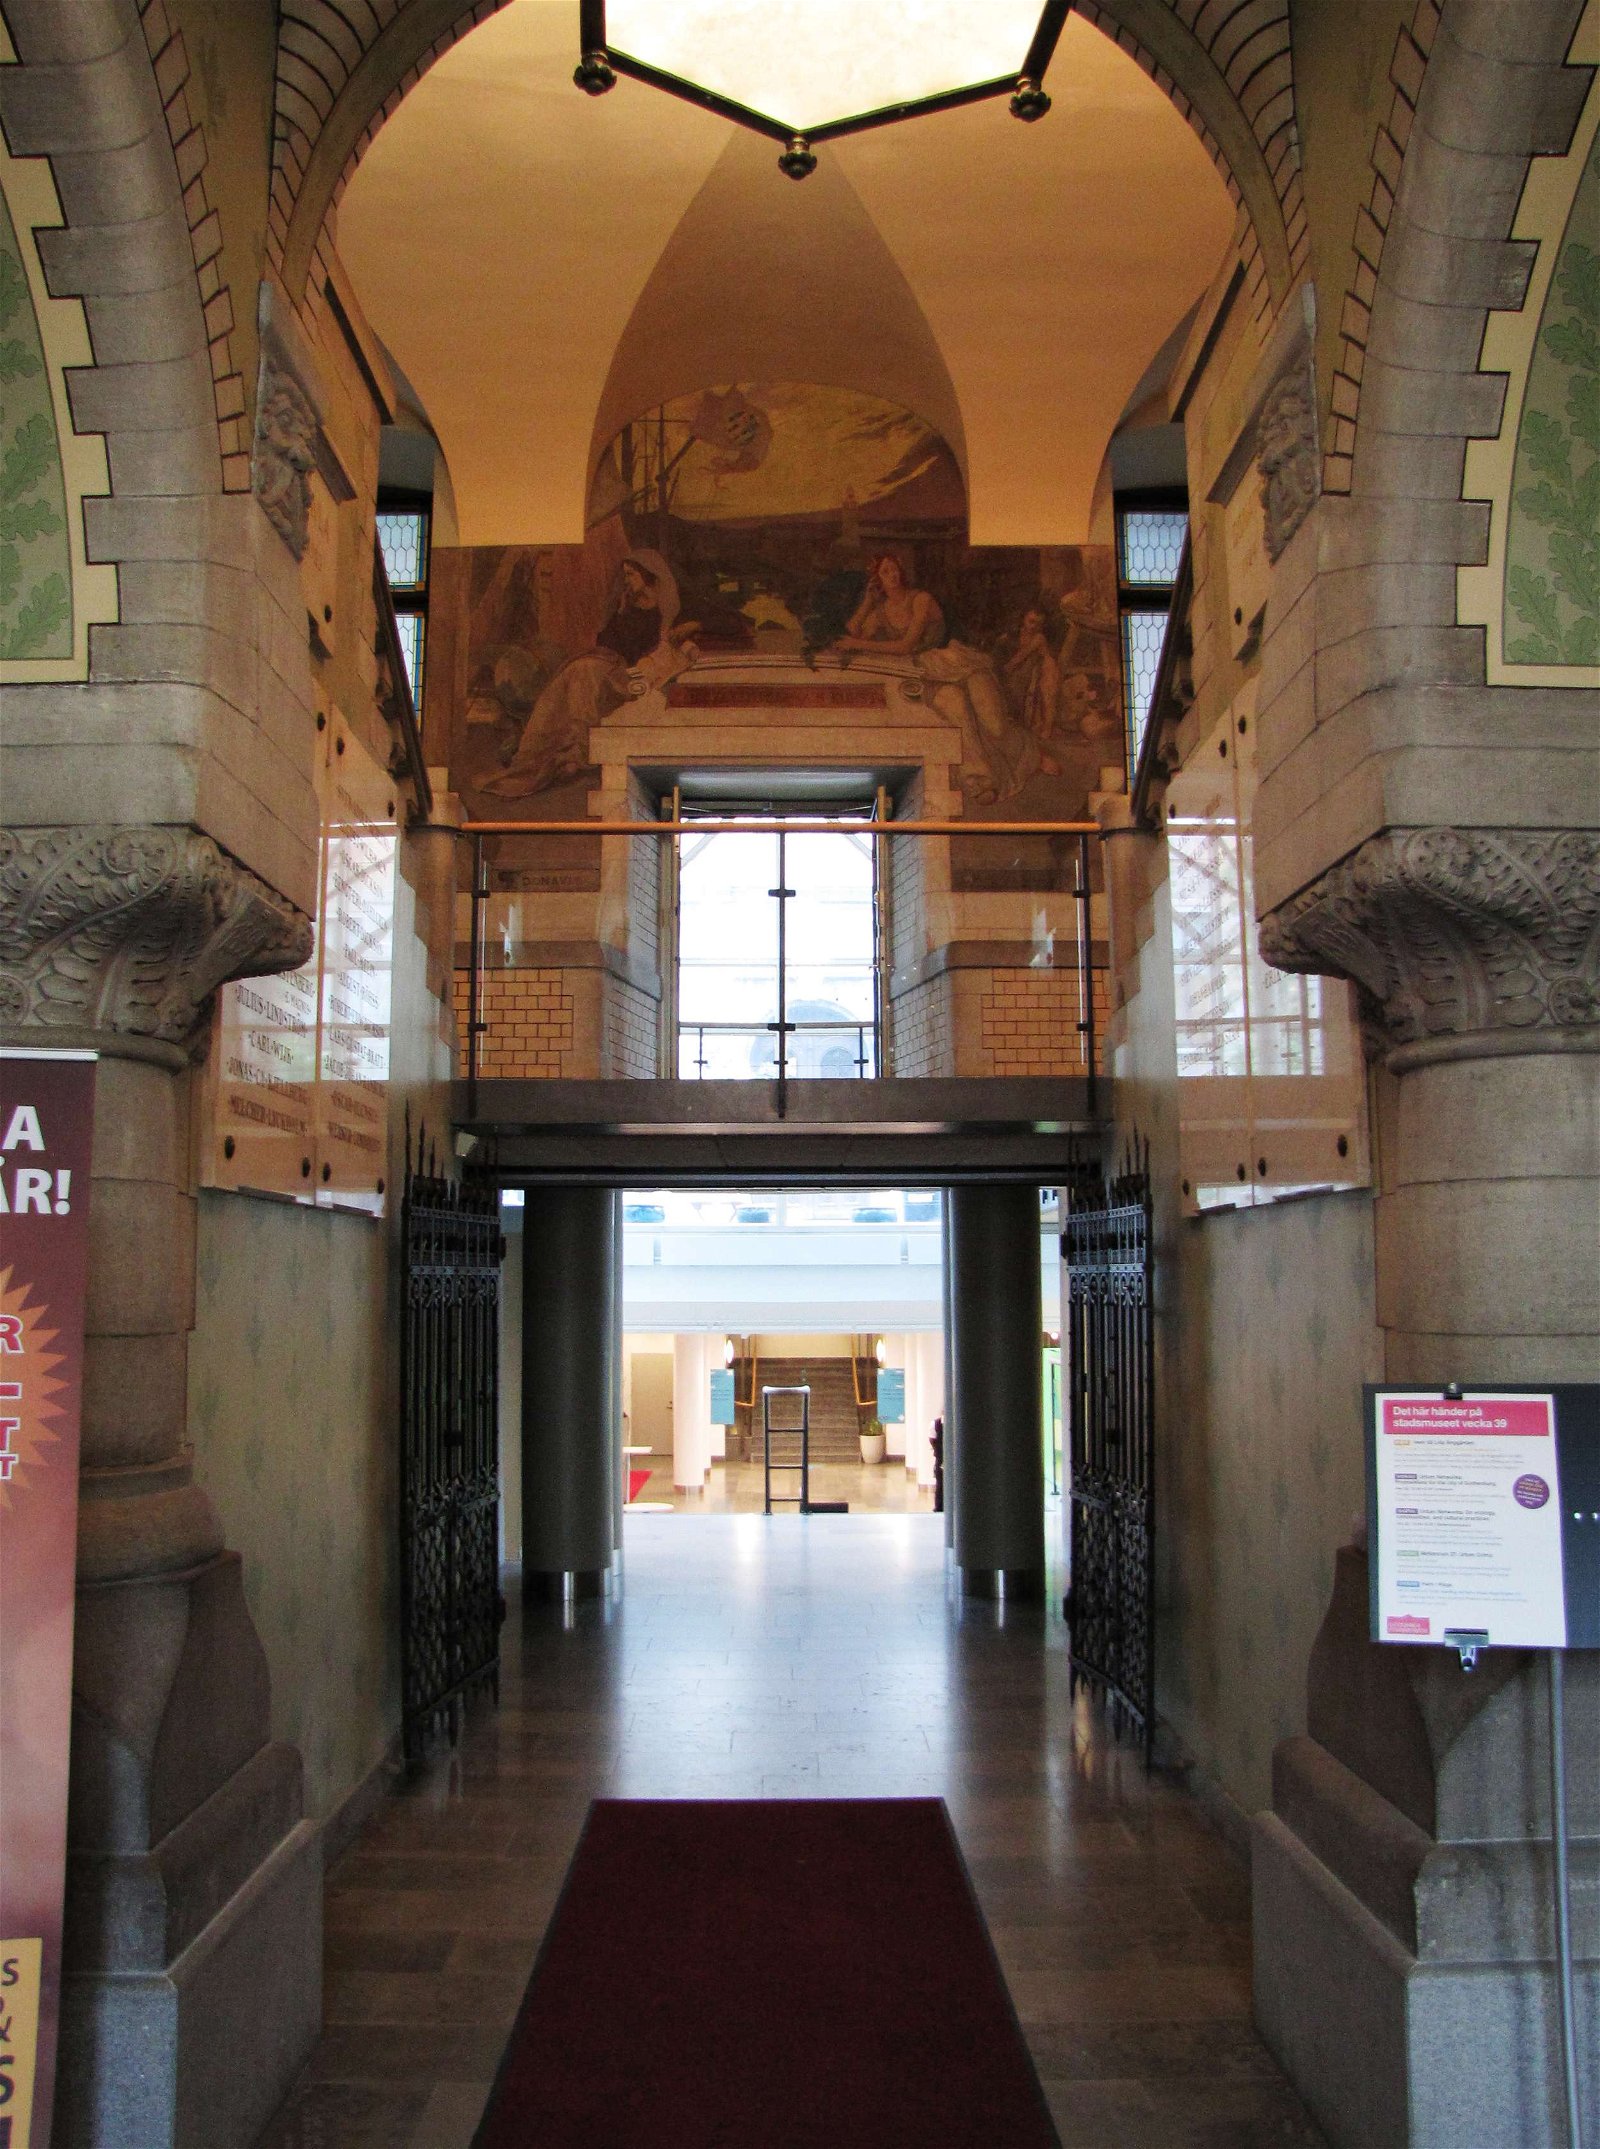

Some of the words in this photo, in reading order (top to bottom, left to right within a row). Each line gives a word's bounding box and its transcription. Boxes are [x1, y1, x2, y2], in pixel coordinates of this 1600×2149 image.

[0, 1156, 72, 1215] R!
[1392, 1406, 1411, 1416] Det
[1412, 1406, 1430, 1416] här
[1431, 1406, 1468, 1416] händer
[1469, 1406, 1483, 1418] på
[1392, 1417, 1461, 1428] stadsmuseet
[1462, 1418, 1493, 1428] vecka
[1494, 1418, 1508, 1428] 39
